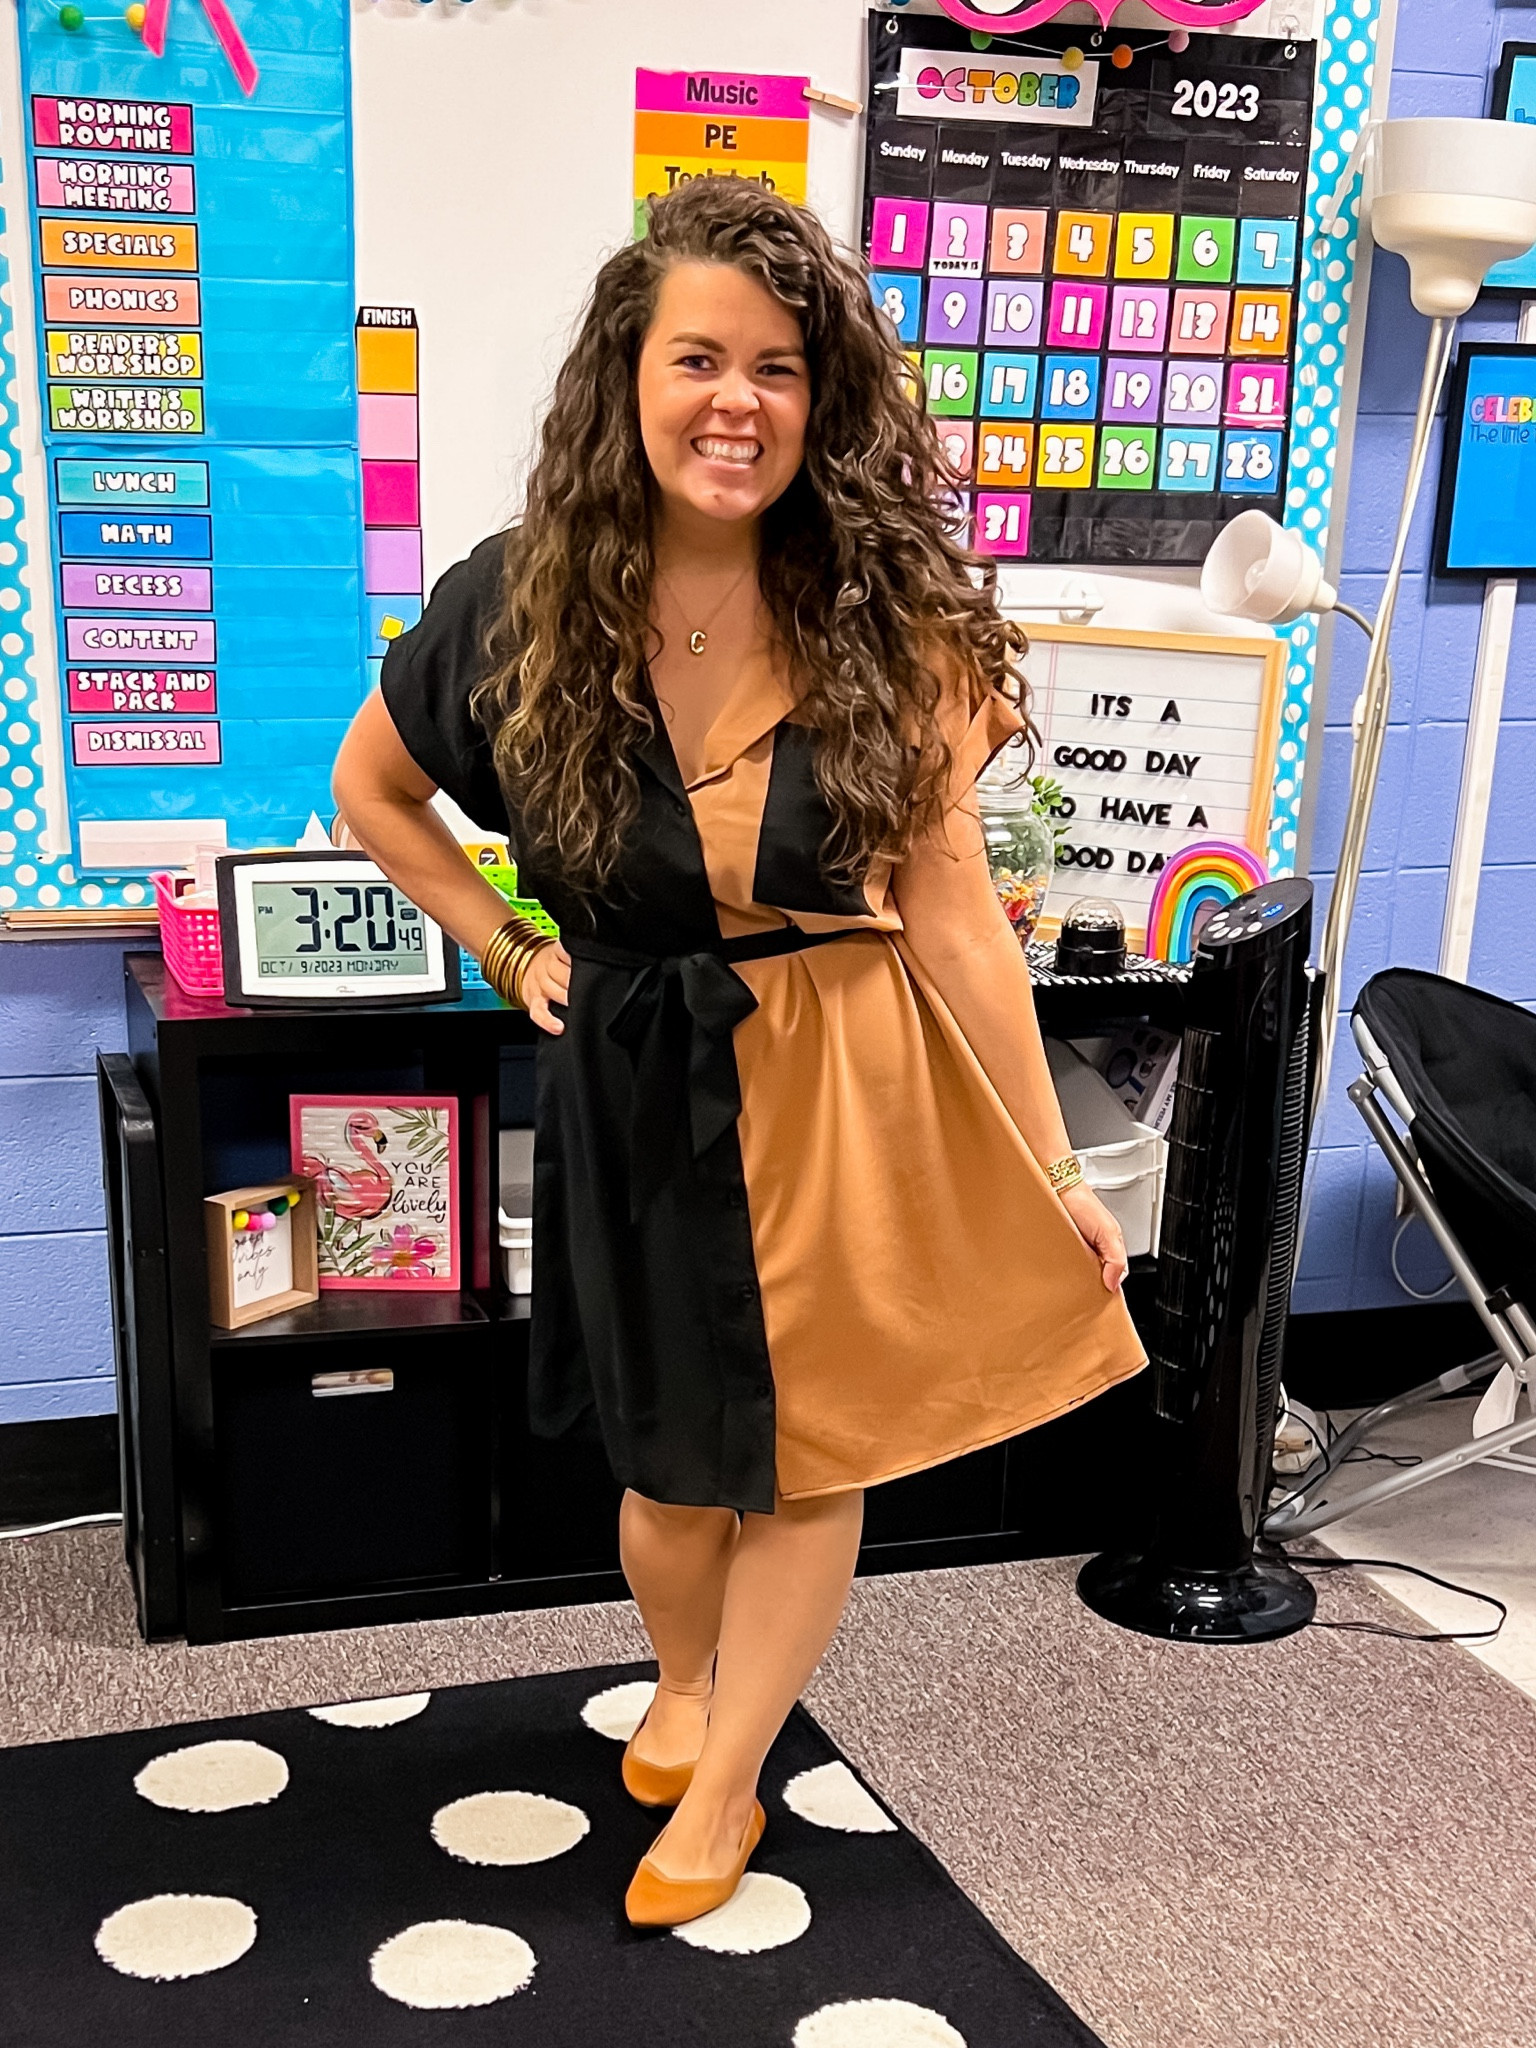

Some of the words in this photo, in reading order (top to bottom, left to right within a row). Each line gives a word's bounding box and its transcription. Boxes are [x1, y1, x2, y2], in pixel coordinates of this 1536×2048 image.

[687, 77, 759, 106] Music
[916, 66, 1080, 108] OCTOBER
[57, 100, 172, 128] MORNING
[1171, 80, 1260, 122] 2023
[59, 123, 172, 151] ROUTINE
[705, 124, 737, 150] PE
[58, 160, 172, 188] MORNING
[880, 141, 926, 162] Sunday
[942, 149, 989, 169] Monday
[1001, 151, 1051, 170] Tuesday
[1059, 156, 1120, 175] Wednesday
[1124, 159, 1179, 179] Thursday
[1193, 164, 1231, 182] Friday
[1244, 166, 1300, 184] Saturday
[63, 185, 171, 212] MEETING
[63, 231, 176, 257] SPECIALS
[890, 213, 908, 254] 1
[947, 216, 968, 258] 2
[1006, 222, 1029, 261] 3
[1068, 224, 1095, 262] 4
[1131, 227, 1155, 264] 5
[1192, 228, 1220, 267] 6
[1254, 232, 1279, 269] 7
[933, 261, 968, 270] TODAY
[69, 288, 179, 311] PHONICS
[362, 309, 413, 326] FINISH
[881, 286, 905, 325] 8
[943, 290, 967, 329] 9
[991, 292, 1034, 332] 10
[1060, 295, 1093, 336] 11
[1120, 299, 1158, 339] 12
[1178, 300, 1218, 340] 13
[1238, 303, 1279, 342] 14
[69, 334, 180, 356] READER'S
[57, 354, 195, 376] WORKSHOP
[70, 388, 182, 410] WRITER'S
[928, 362, 969, 401] 16
[991, 366, 1028, 405] 17
[1049, 368, 1090, 408] 18
[1111, 370, 1152, 409] 19
[1169, 372, 1218, 412] 20
[1237, 375, 1276, 414] 21
[57, 407, 196, 430] WORKSHOP
[1471, 395, 1536, 424] CELEB
[982, 434, 1027, 474] 24
[1043, 435, 1085, 474] 25
[1102, 438, 1150, 477] 26
[1166, 440, 1212, 478] 27
[1225, 441, 1276, 480] 28
[92, 471, 177, 494] LUNCH
[100, 524, 173, 545] MATH
[983, 504, 1021, 543] 31
[96, 575, 183, 596] RECESS
[83, 629, 198, 651] CONTENT
[76, 672, 157, 692] STACK
[165, 673, 211, 692] AND
[113, 692, 177, 711] PACK
[1090, 693, 1133, 718] ITS
[1160, 700, 1182, 723] A
[88, 731, 207, 751] DISMISSAL
[1053, 745, 1127, 773] GOOD
[1145, 750, 1202, 778] DAY
[1100, 797, 1172, 825] HAVE
[1187, 805, 1209, 829] A
[1056, 844, 1115, 870] OOD
[1127, 851, 1171, 874] DA
[258, 906, 273, 914] PM
[291, 887, 397, 952] 3:20
[399, 927, 423, 951] 49
[347, 960, 399, 972] MONDAY
[391, 1161, 433, 1175] YOU
[404, 1176, 441, 1188] ARE
[392, 1189, 447, 1223] lovely
